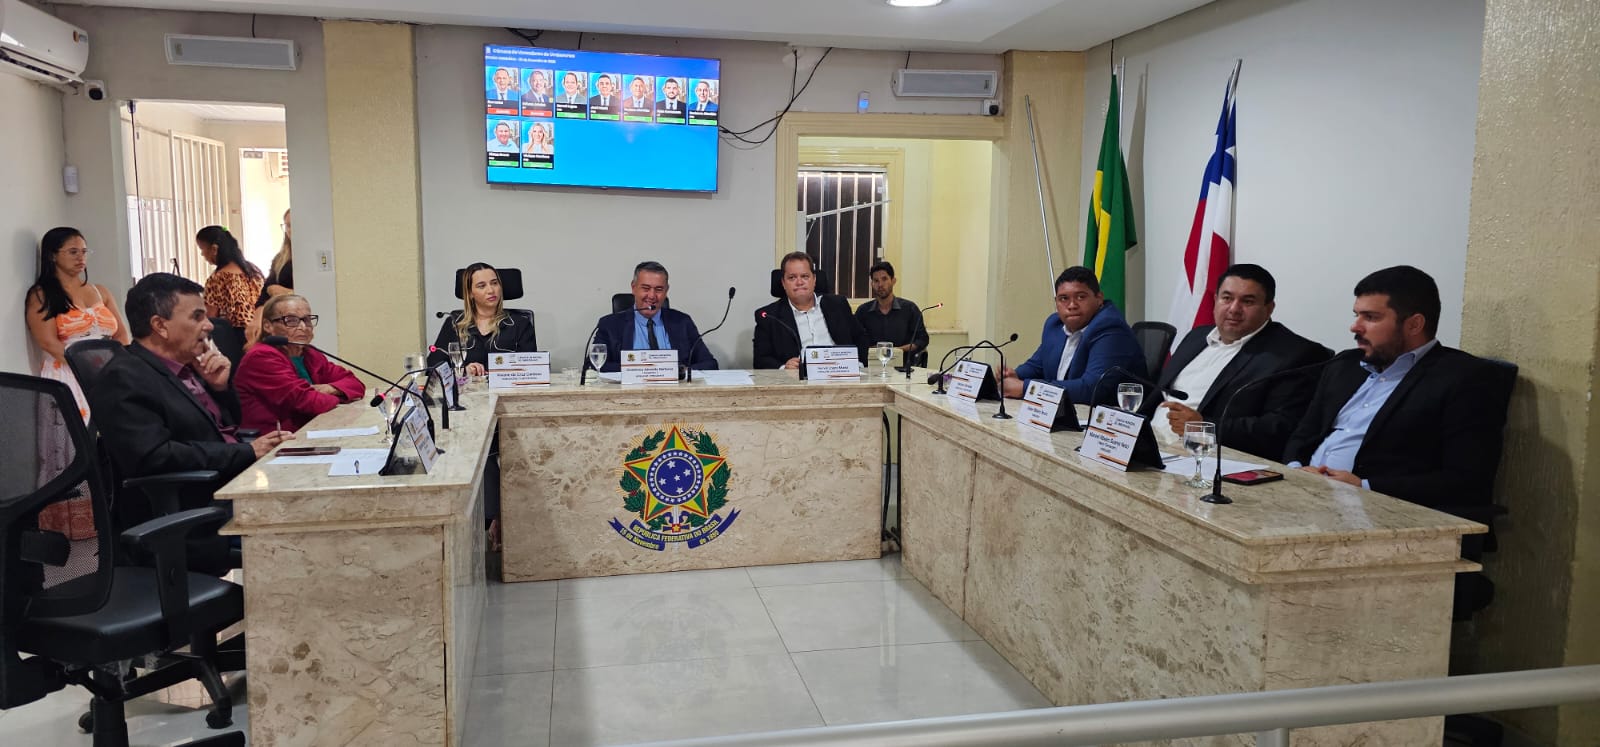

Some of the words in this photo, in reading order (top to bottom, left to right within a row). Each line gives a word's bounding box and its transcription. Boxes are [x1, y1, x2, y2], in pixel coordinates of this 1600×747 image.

[661, 532, 694, 542] FEDERATIVA
[701, 520, 720, 533] BRASIL
[633, 536, 660, 550] Novembro
